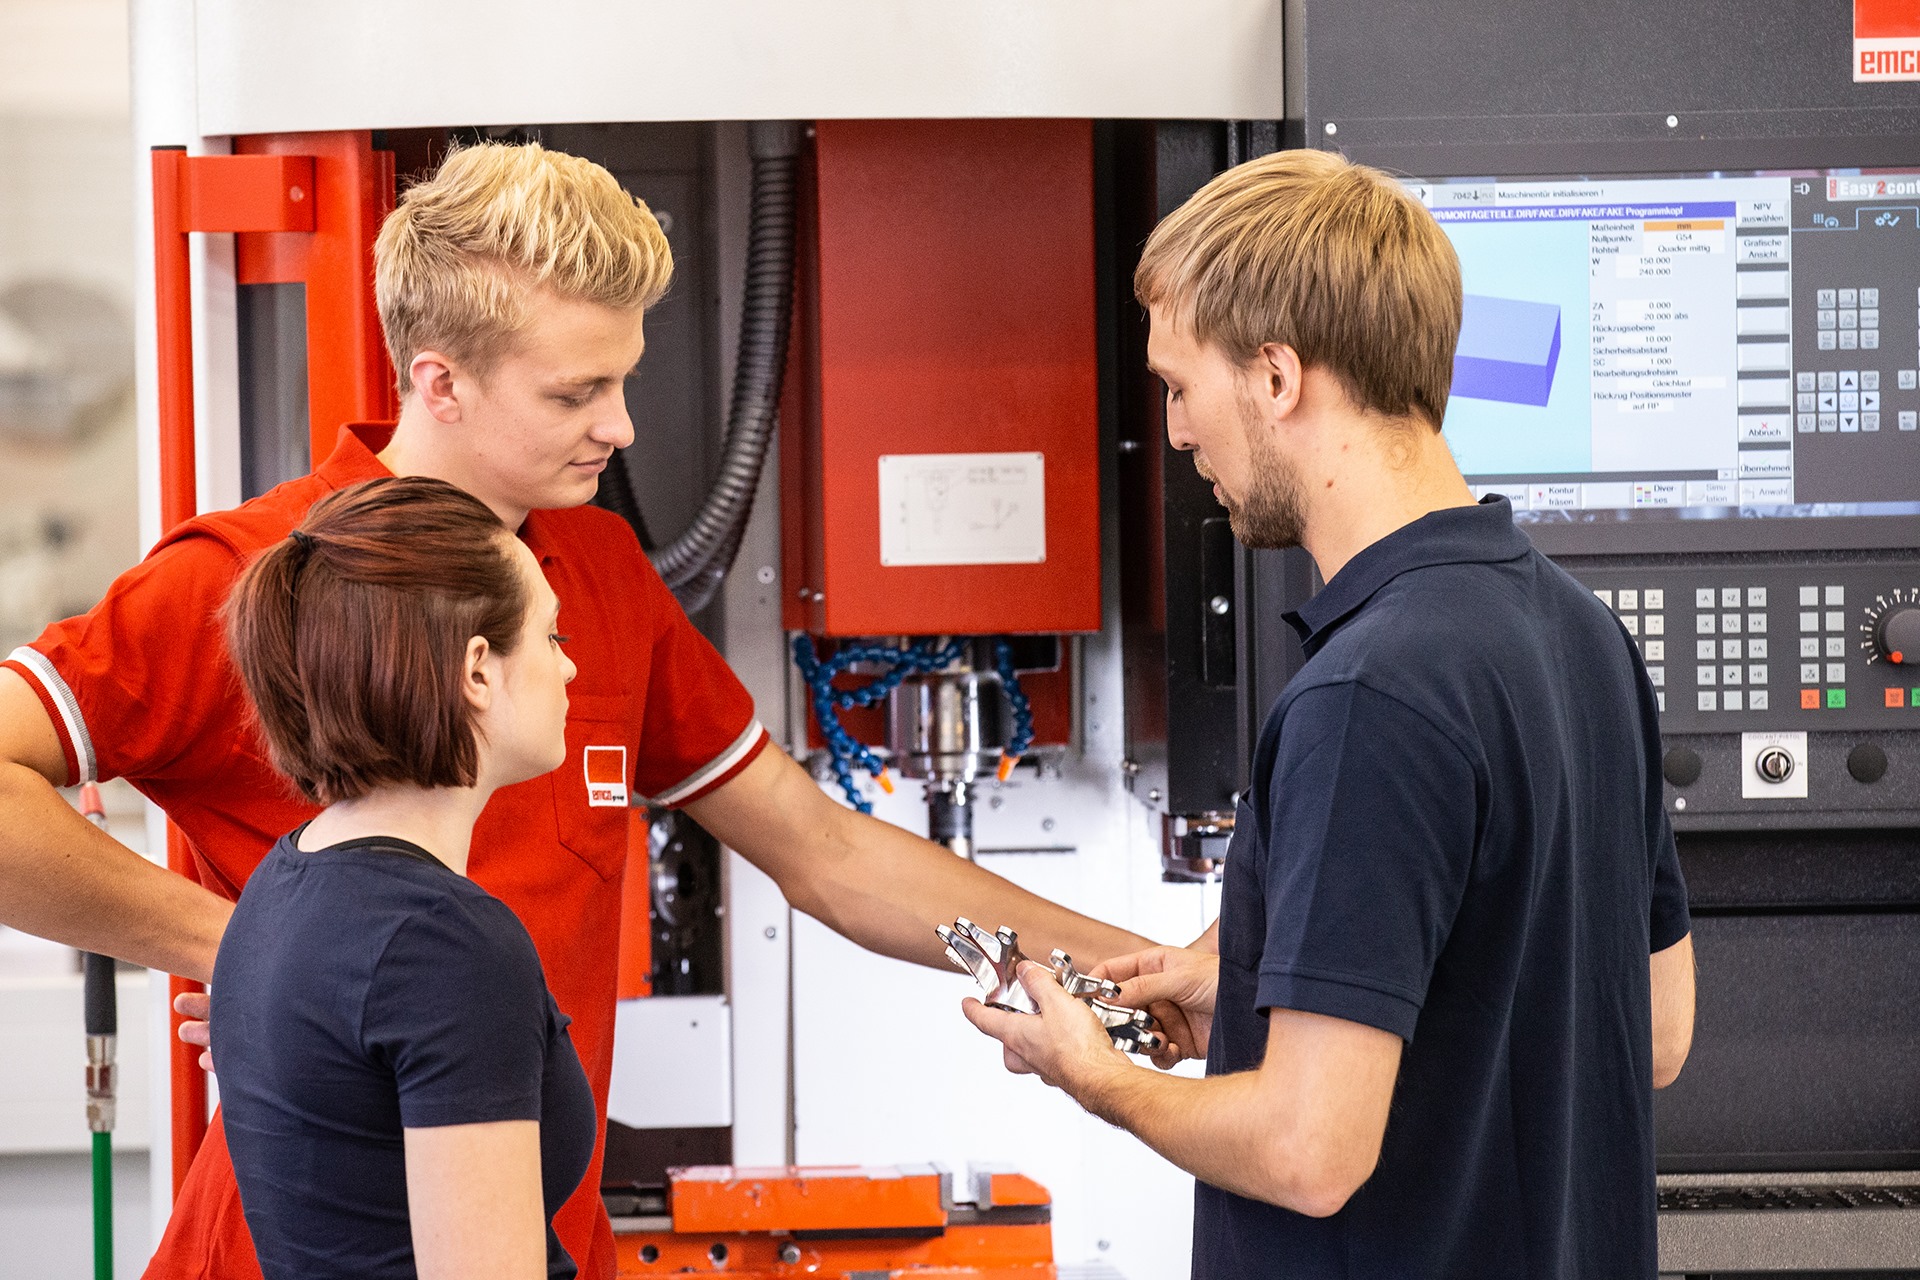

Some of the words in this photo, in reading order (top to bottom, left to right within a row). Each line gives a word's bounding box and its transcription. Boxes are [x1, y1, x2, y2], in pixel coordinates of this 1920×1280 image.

[1861, 51, 1920, 74] emc
[1498, 190, 1550, 199] Maschinentür
[1553, 189, 1599, 198] initialisieren
[1626, 206, 1683, 217] Programmkopf
[1742, 214, 1784, 223] auswählen
[1743, 239, 1782, 247] Grafische
[1658, 245, 1686, 253] Quader
[1689, 244, 1711, 253] mittig
[1674, 312, 1689, 320] abs
[1592, 325, 1655, 333] Rückzugsebene
[1593, 347, 1667, 355] Sicherheitsabstand
[1593, 369, 1678, 377] Bearbeitungsdrehsinn
[1652, 379, 1691, 387] Gleichlauf
[1593, 391, 1628, 400] Rückzug
[1629, 390, 1692, 399] Positionsmuster
[1748, 428, 1781, 436] Abbruch
[1740, 463, 1790, 472] Übernehmen
[1548, 486, 1575, 494] Kontur
[1758, 487, 1788, 496] Anwahl
[1548, 498, 1574, 506] fräsen
